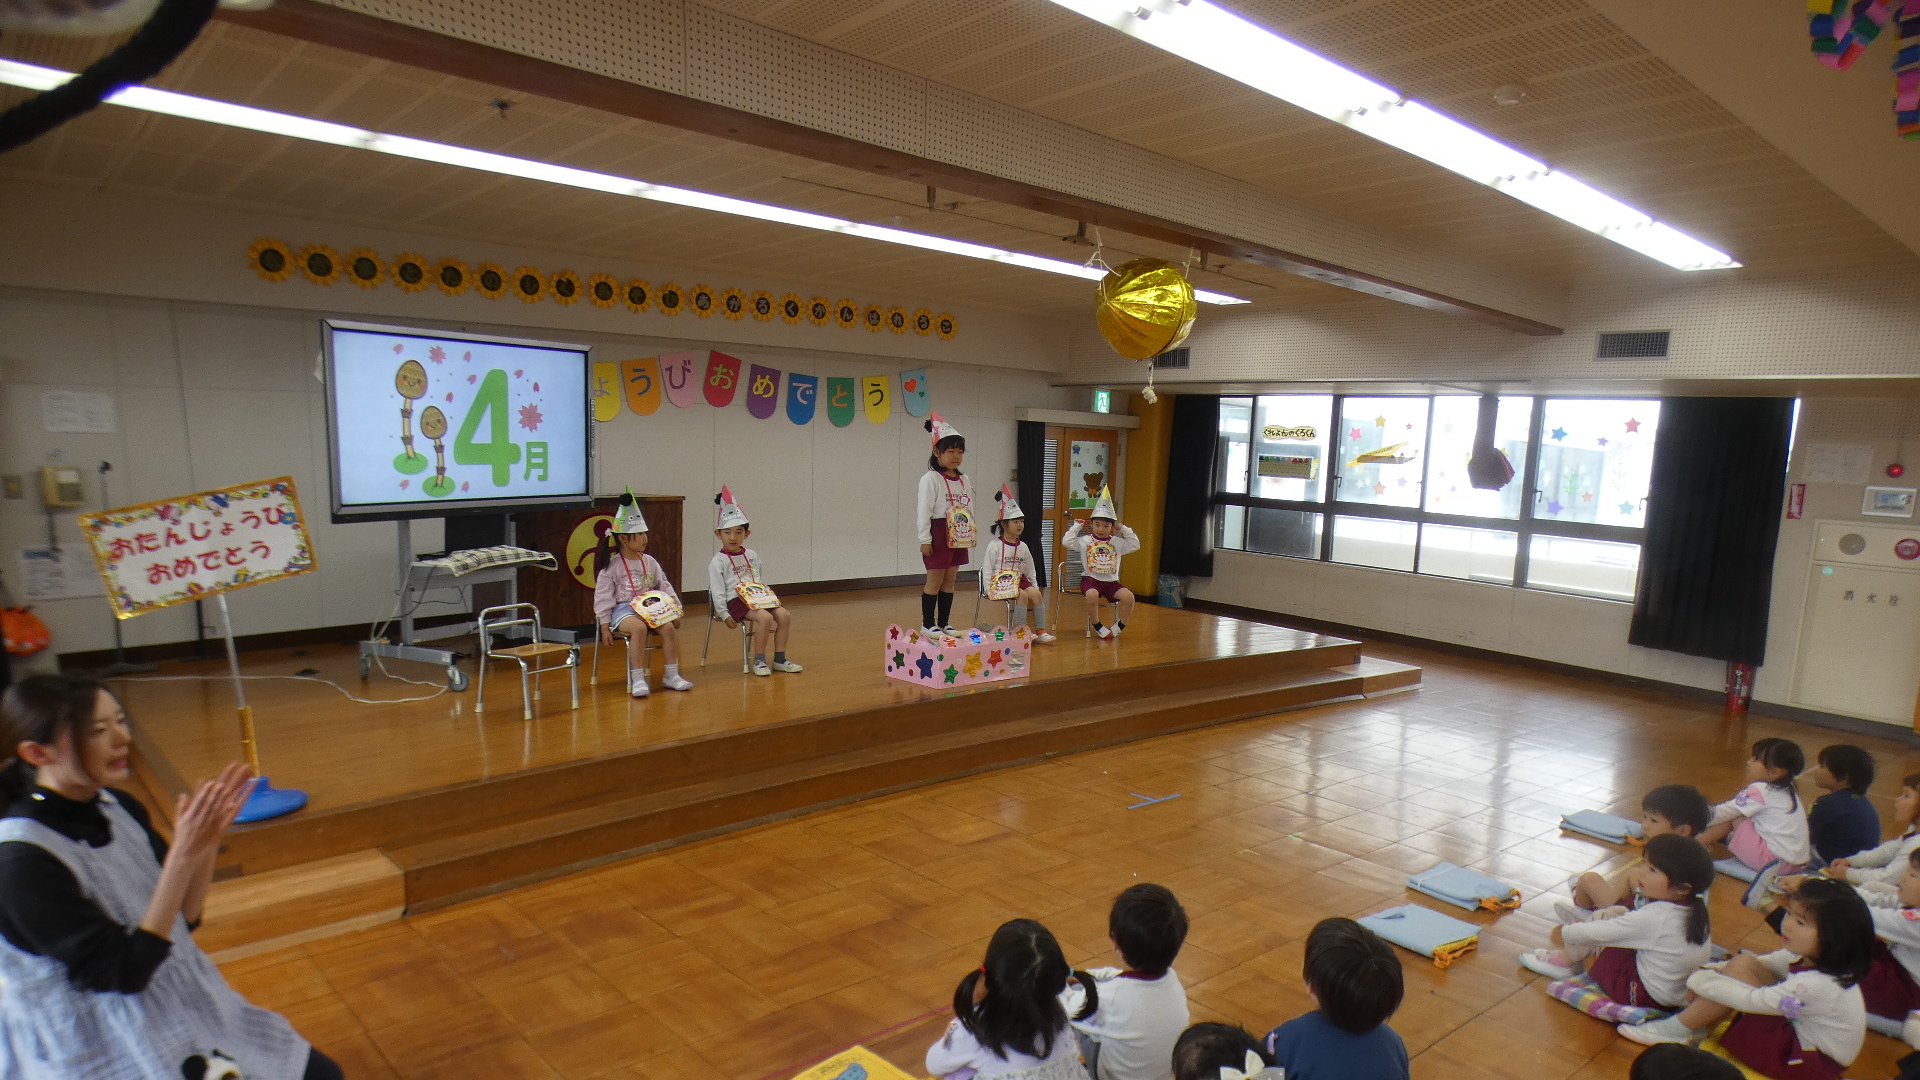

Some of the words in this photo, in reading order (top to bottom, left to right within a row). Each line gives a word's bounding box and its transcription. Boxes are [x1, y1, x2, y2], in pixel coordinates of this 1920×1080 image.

[453, 368, 549, 487] 4月
[146, 540, 271, 585] おめでとう
